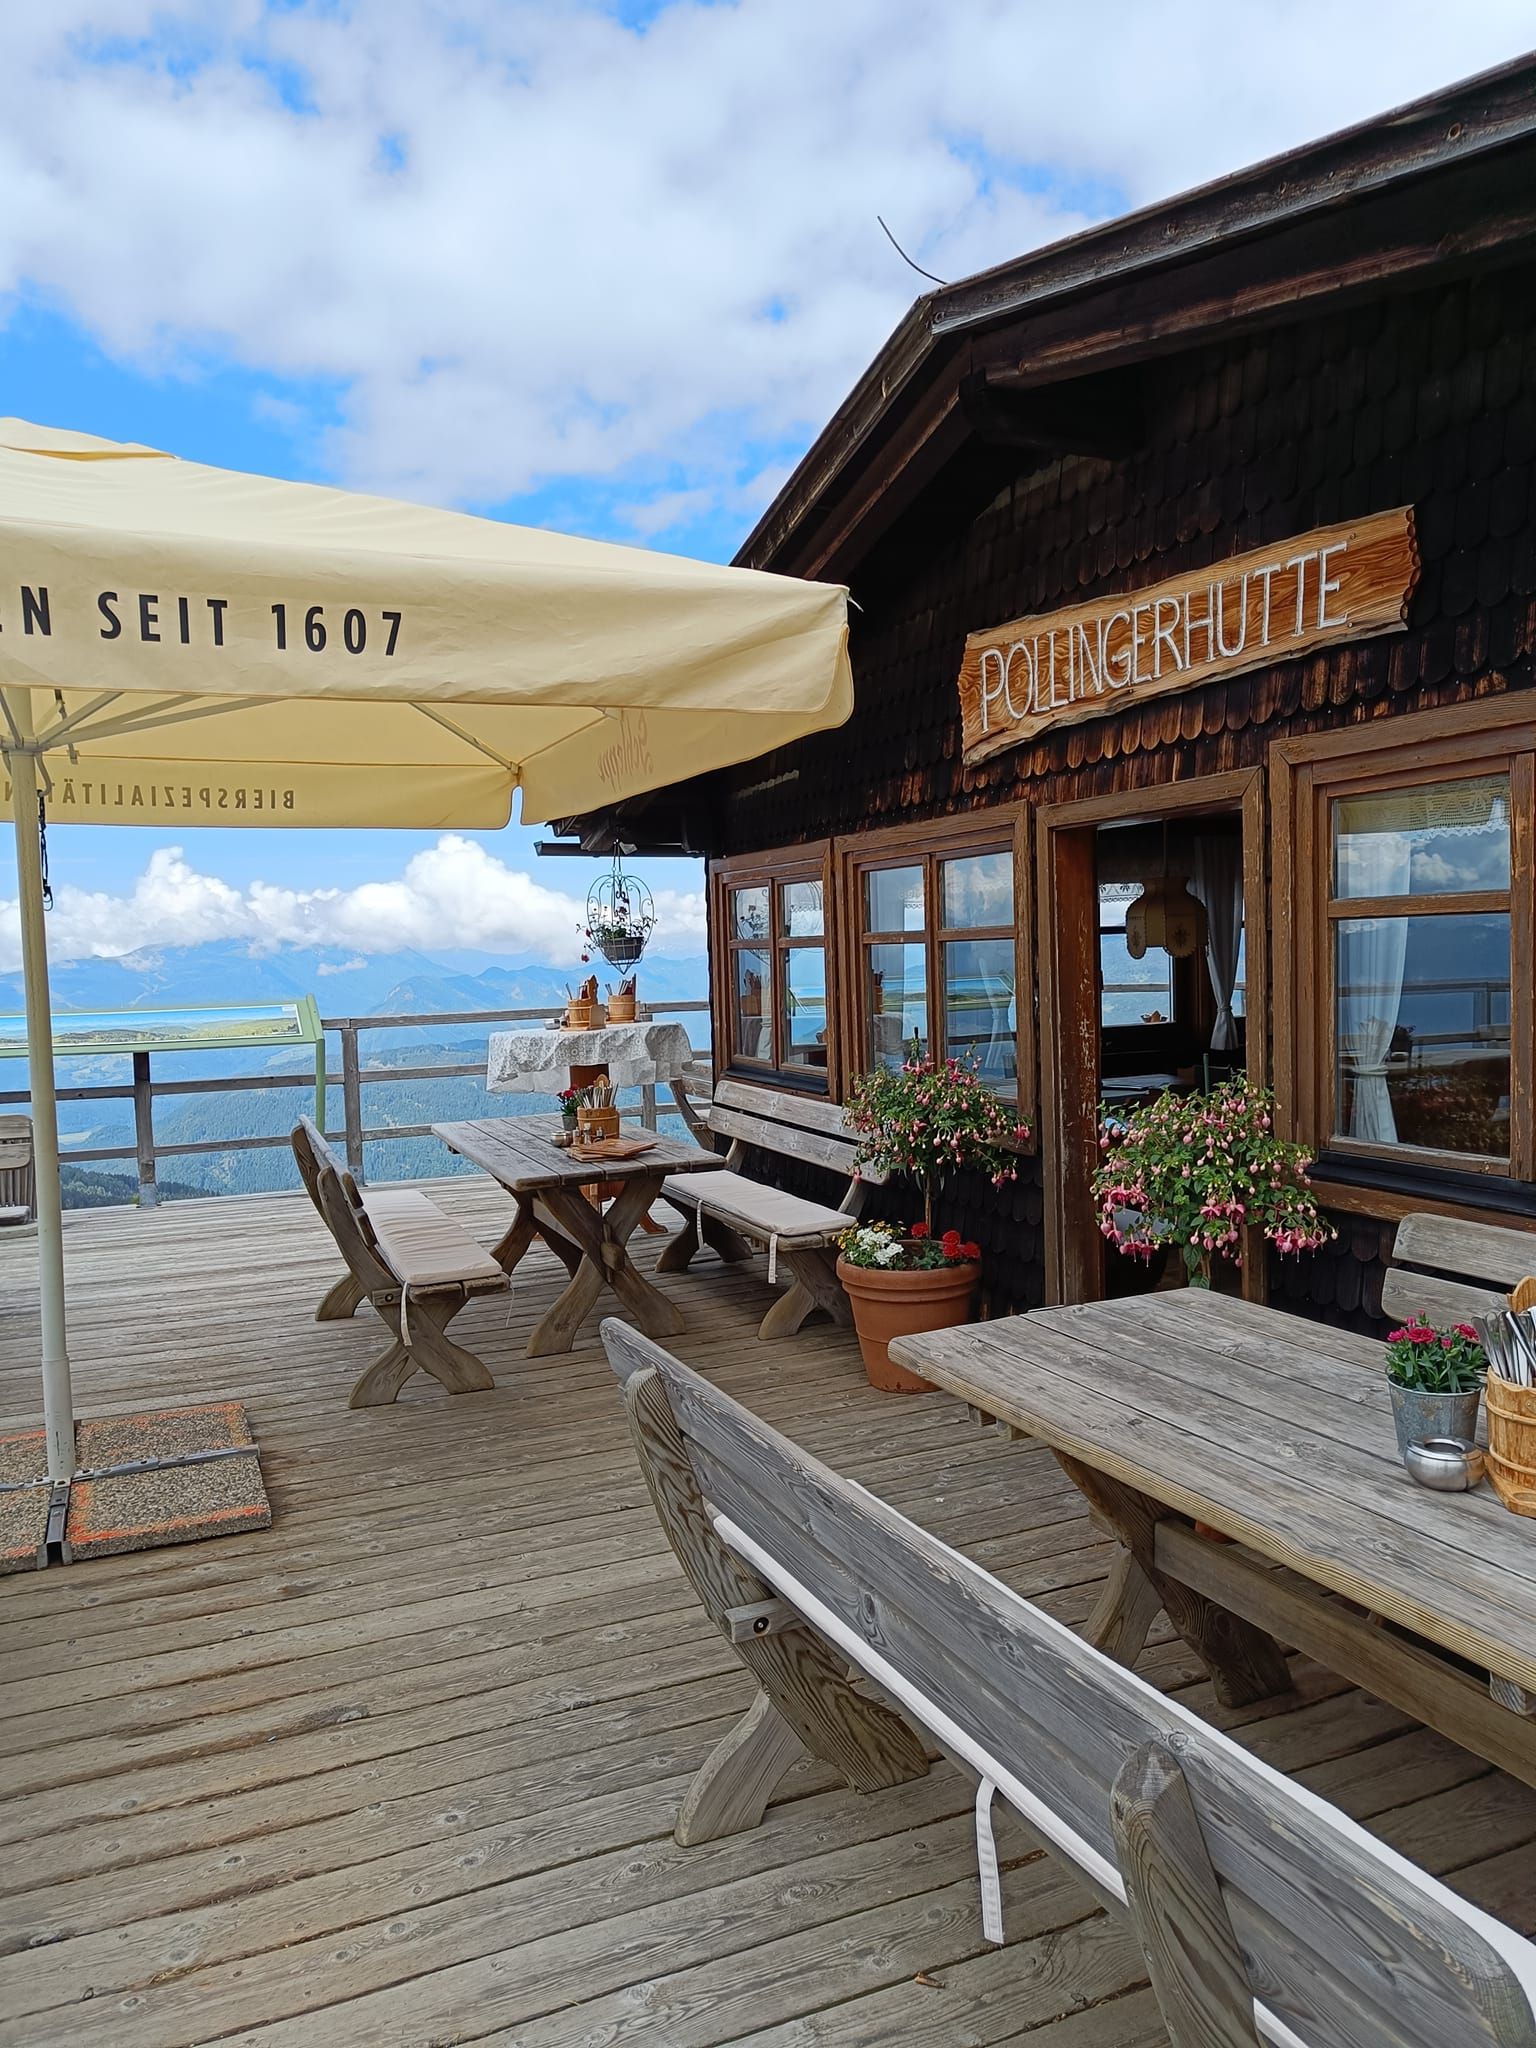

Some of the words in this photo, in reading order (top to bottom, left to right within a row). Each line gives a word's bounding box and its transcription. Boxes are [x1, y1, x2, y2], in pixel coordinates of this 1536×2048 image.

[0, 585, 52, 637] N
[97, 591, 229, 647] SEIT
[271, 603, 402, 657] 1607
